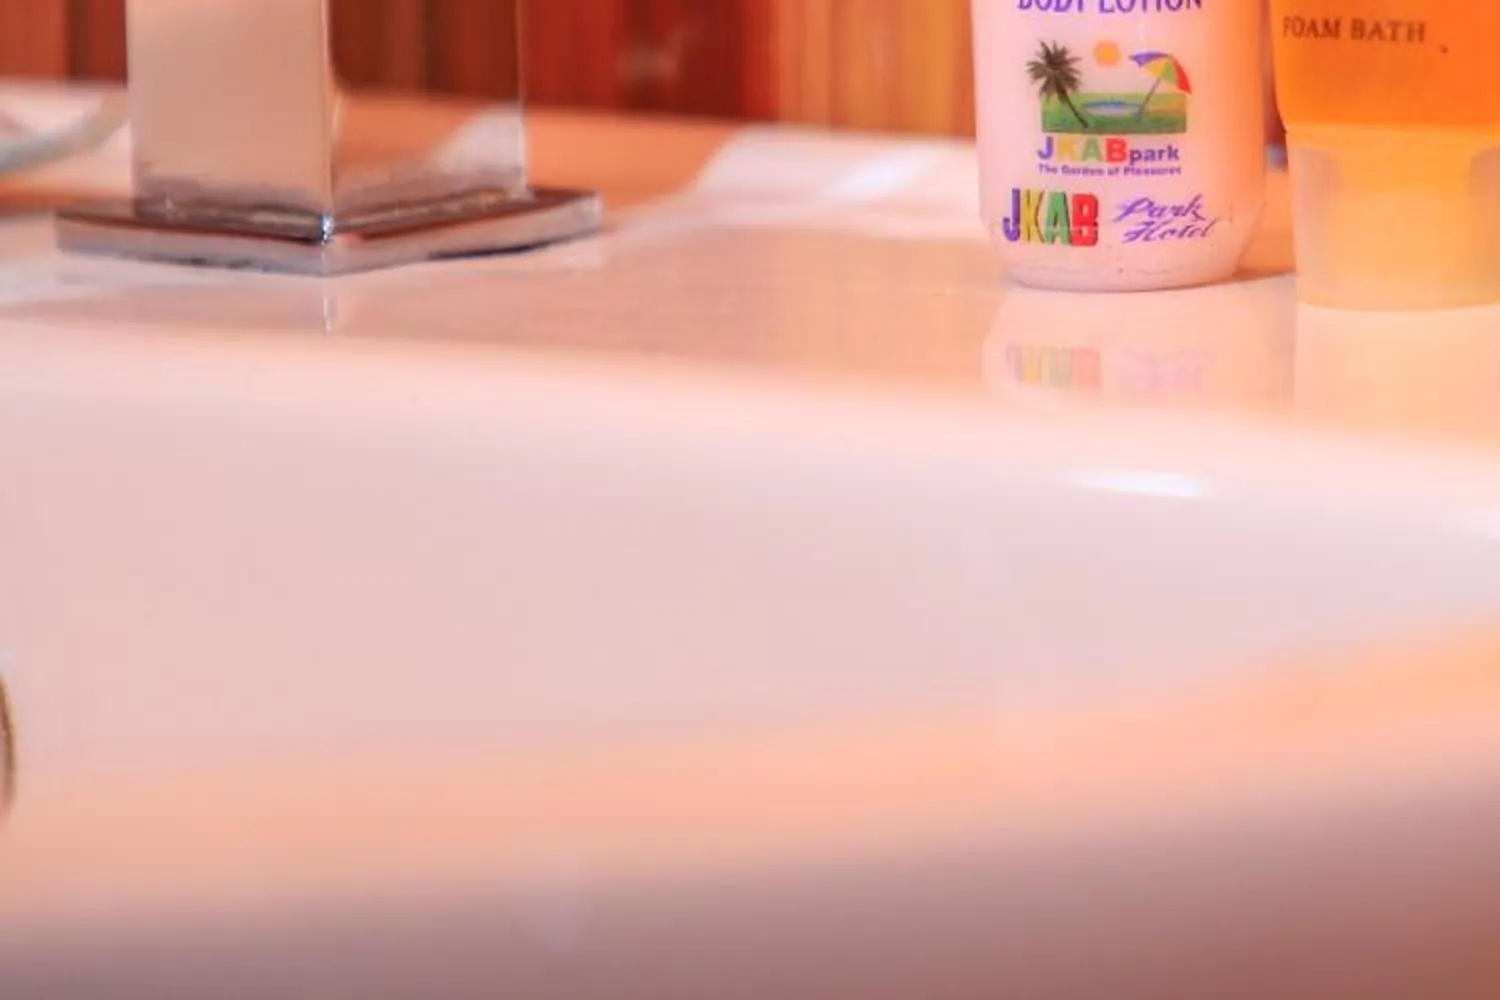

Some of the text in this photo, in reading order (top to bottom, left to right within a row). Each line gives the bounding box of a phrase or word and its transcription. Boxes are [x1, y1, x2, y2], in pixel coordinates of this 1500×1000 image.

[1282, 15, 1426, 43] FOAM BATH
[1039, 163, 1058, 175] The
[1002, 188, 1099, 247] JKAB
[1112, 193, 1206, 222] Park
